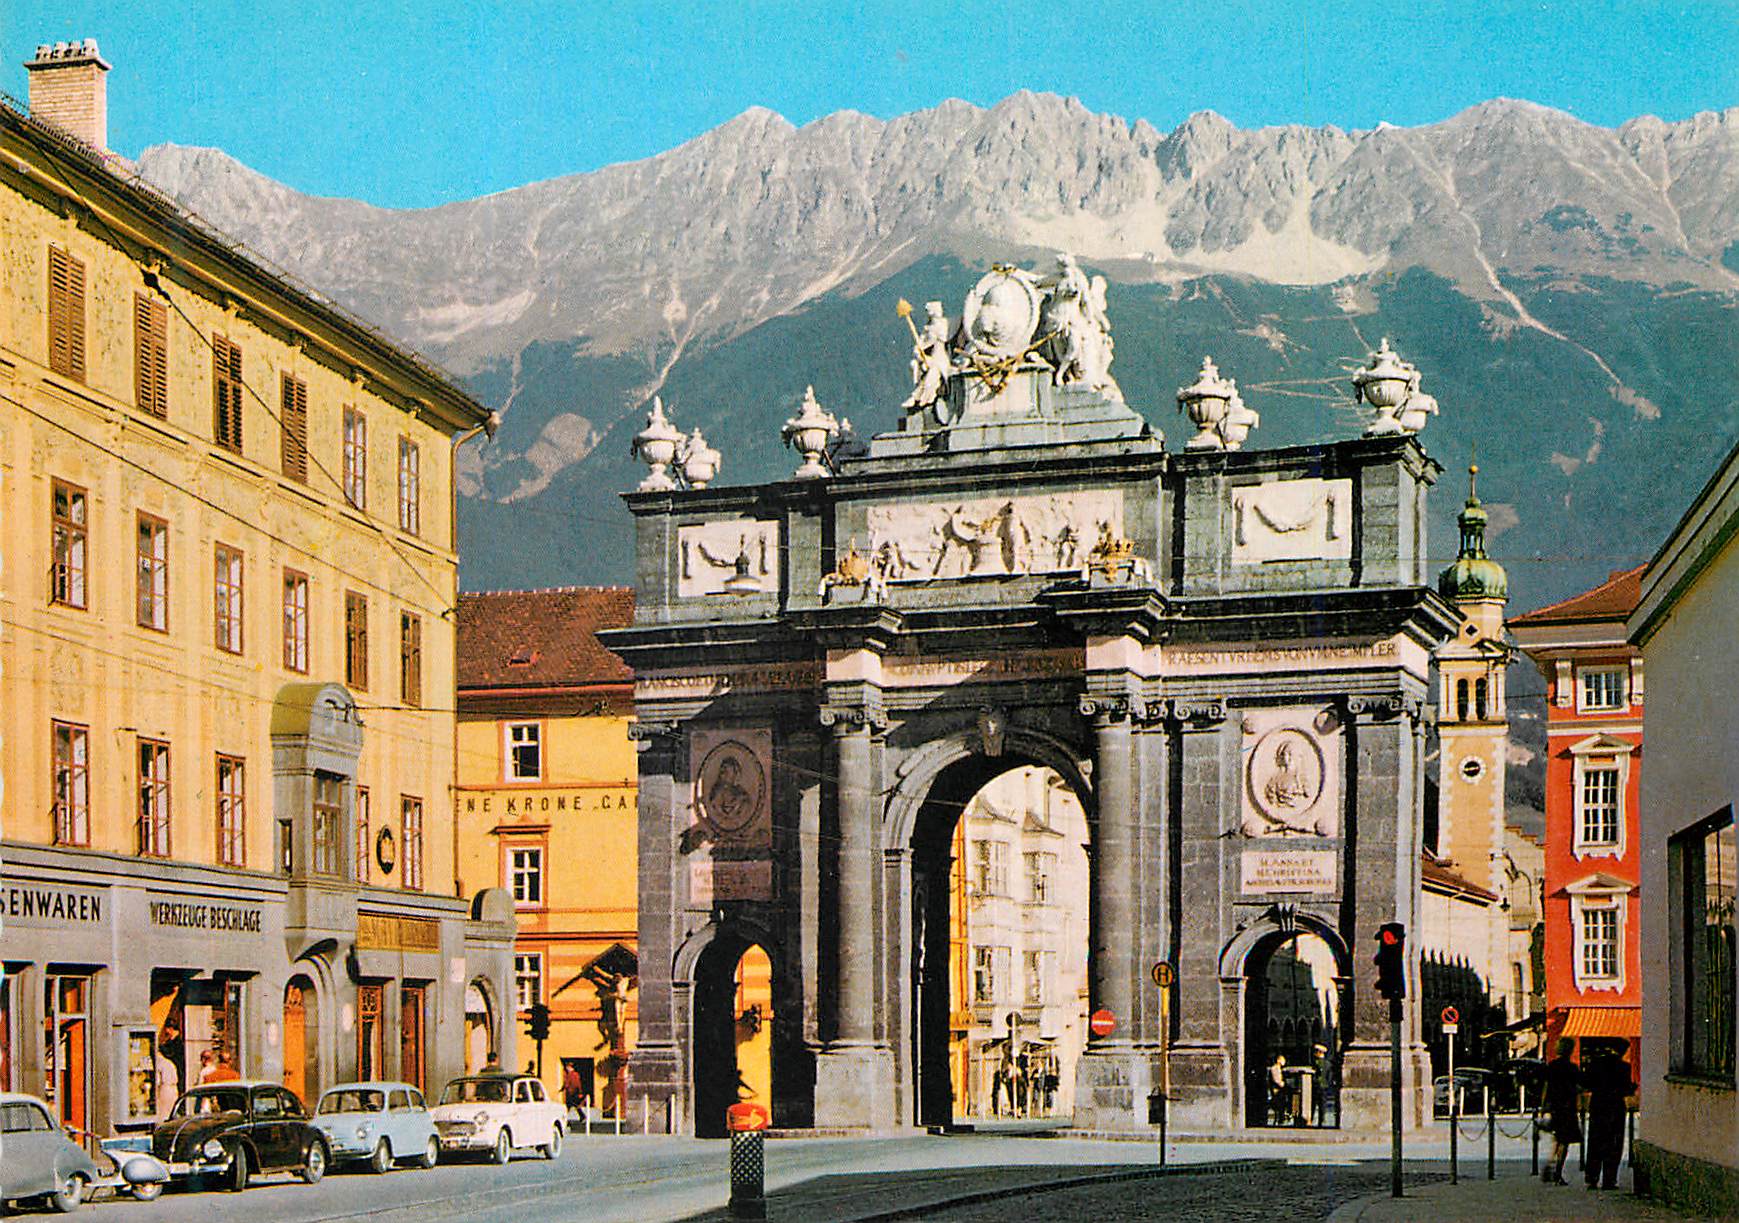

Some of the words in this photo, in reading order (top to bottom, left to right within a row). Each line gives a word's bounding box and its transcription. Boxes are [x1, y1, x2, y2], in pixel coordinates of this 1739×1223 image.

[507, 796, 582, 812] KRONE
[602, 794, 638, 810] CA
[150, 901, 207, 928] WERKZEUGE
[1157, 967, 1169, 984] H
